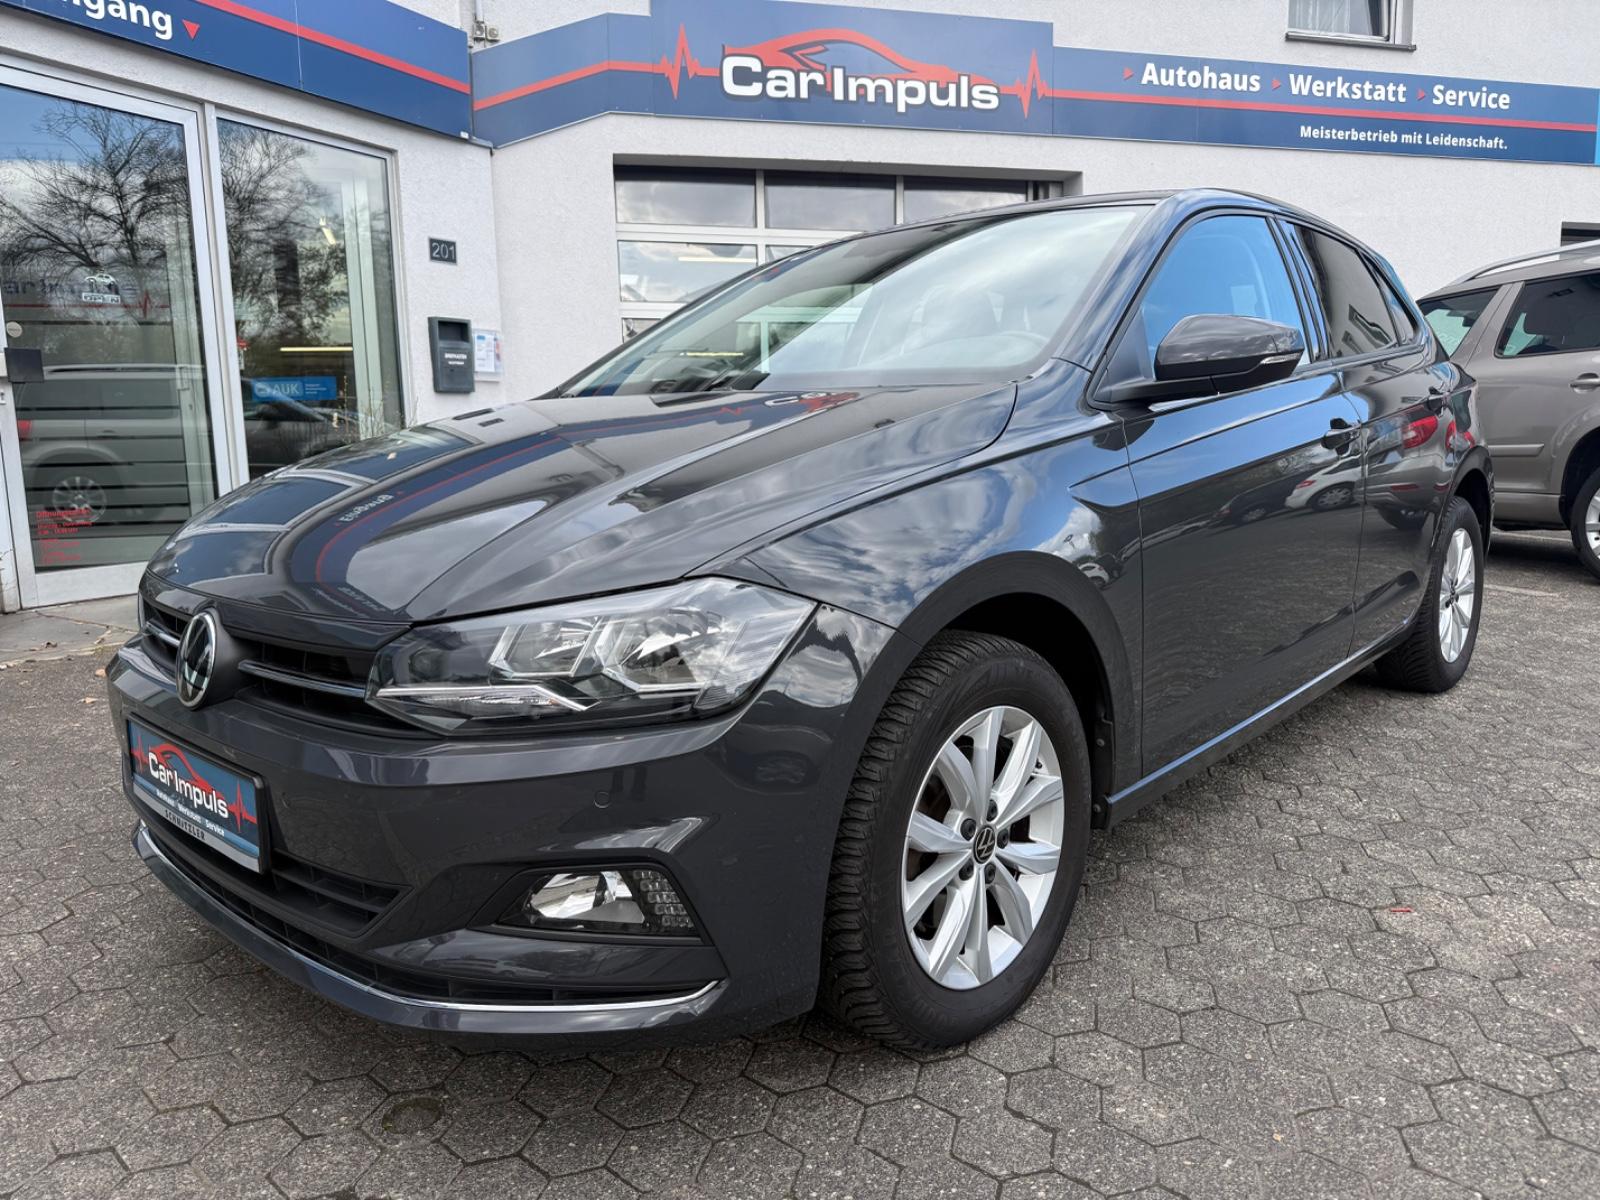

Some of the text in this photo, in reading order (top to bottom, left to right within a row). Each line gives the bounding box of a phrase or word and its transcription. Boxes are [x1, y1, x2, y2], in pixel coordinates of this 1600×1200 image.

[63, 0, 173, 40] gang
[721, 55, 1000, 113] Car Impuls
[1141, 62, 1511, 110] Autohaus Werkstatt Service
[1300, 125, 1508, 150] Meisterbetrieb mit Leidenschaft.
[431, 242, 455, 260] 201
[148, 752, 230, 820] Car Impuls
